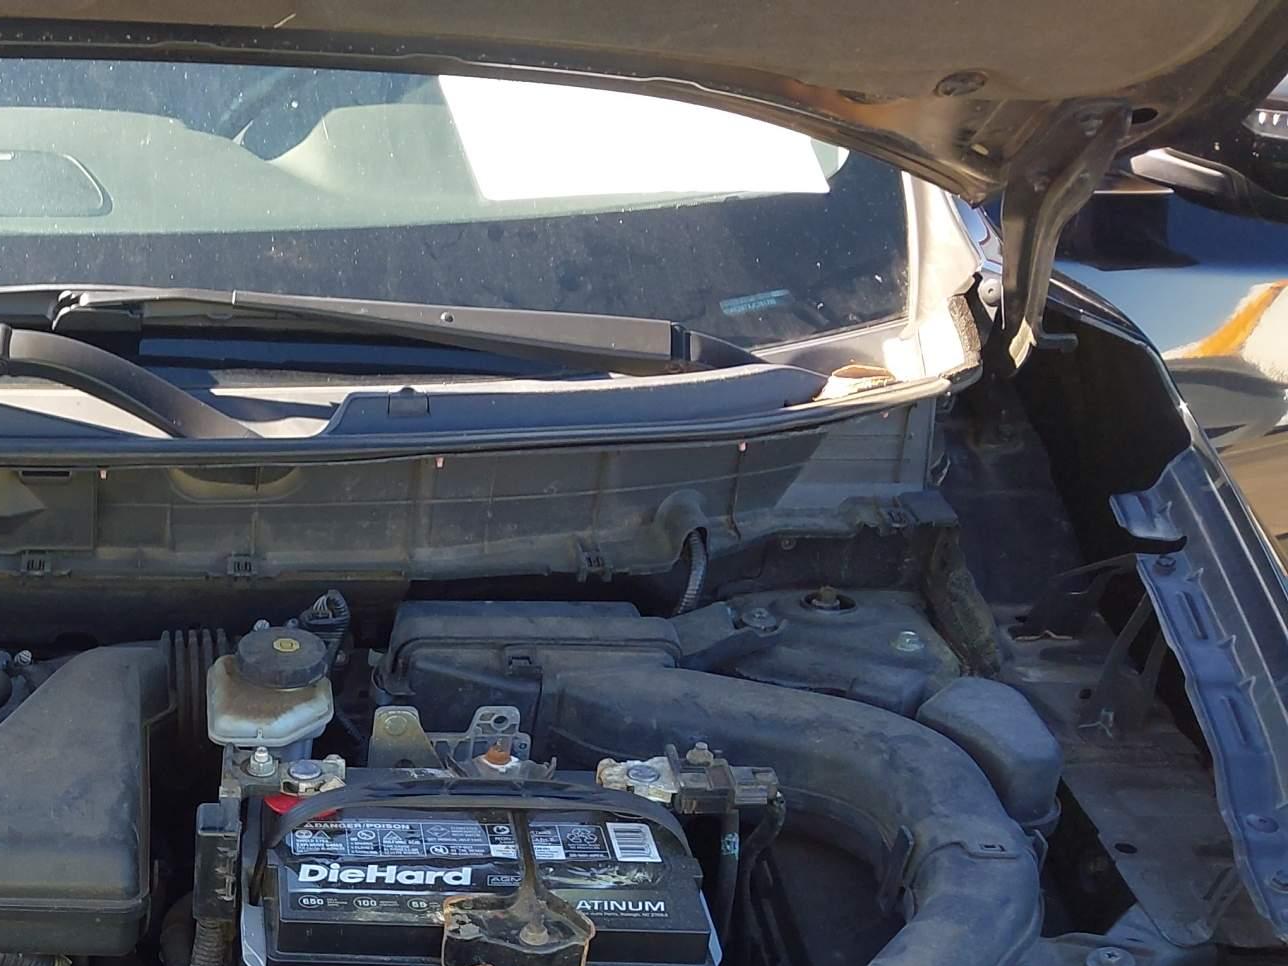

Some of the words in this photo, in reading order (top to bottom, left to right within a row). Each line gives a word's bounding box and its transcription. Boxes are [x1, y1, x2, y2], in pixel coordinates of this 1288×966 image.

[298, 862, 472, 886] DieHard
[357, 899, 377, 907] 100
[576, 900, 666, 912] ATINUM
